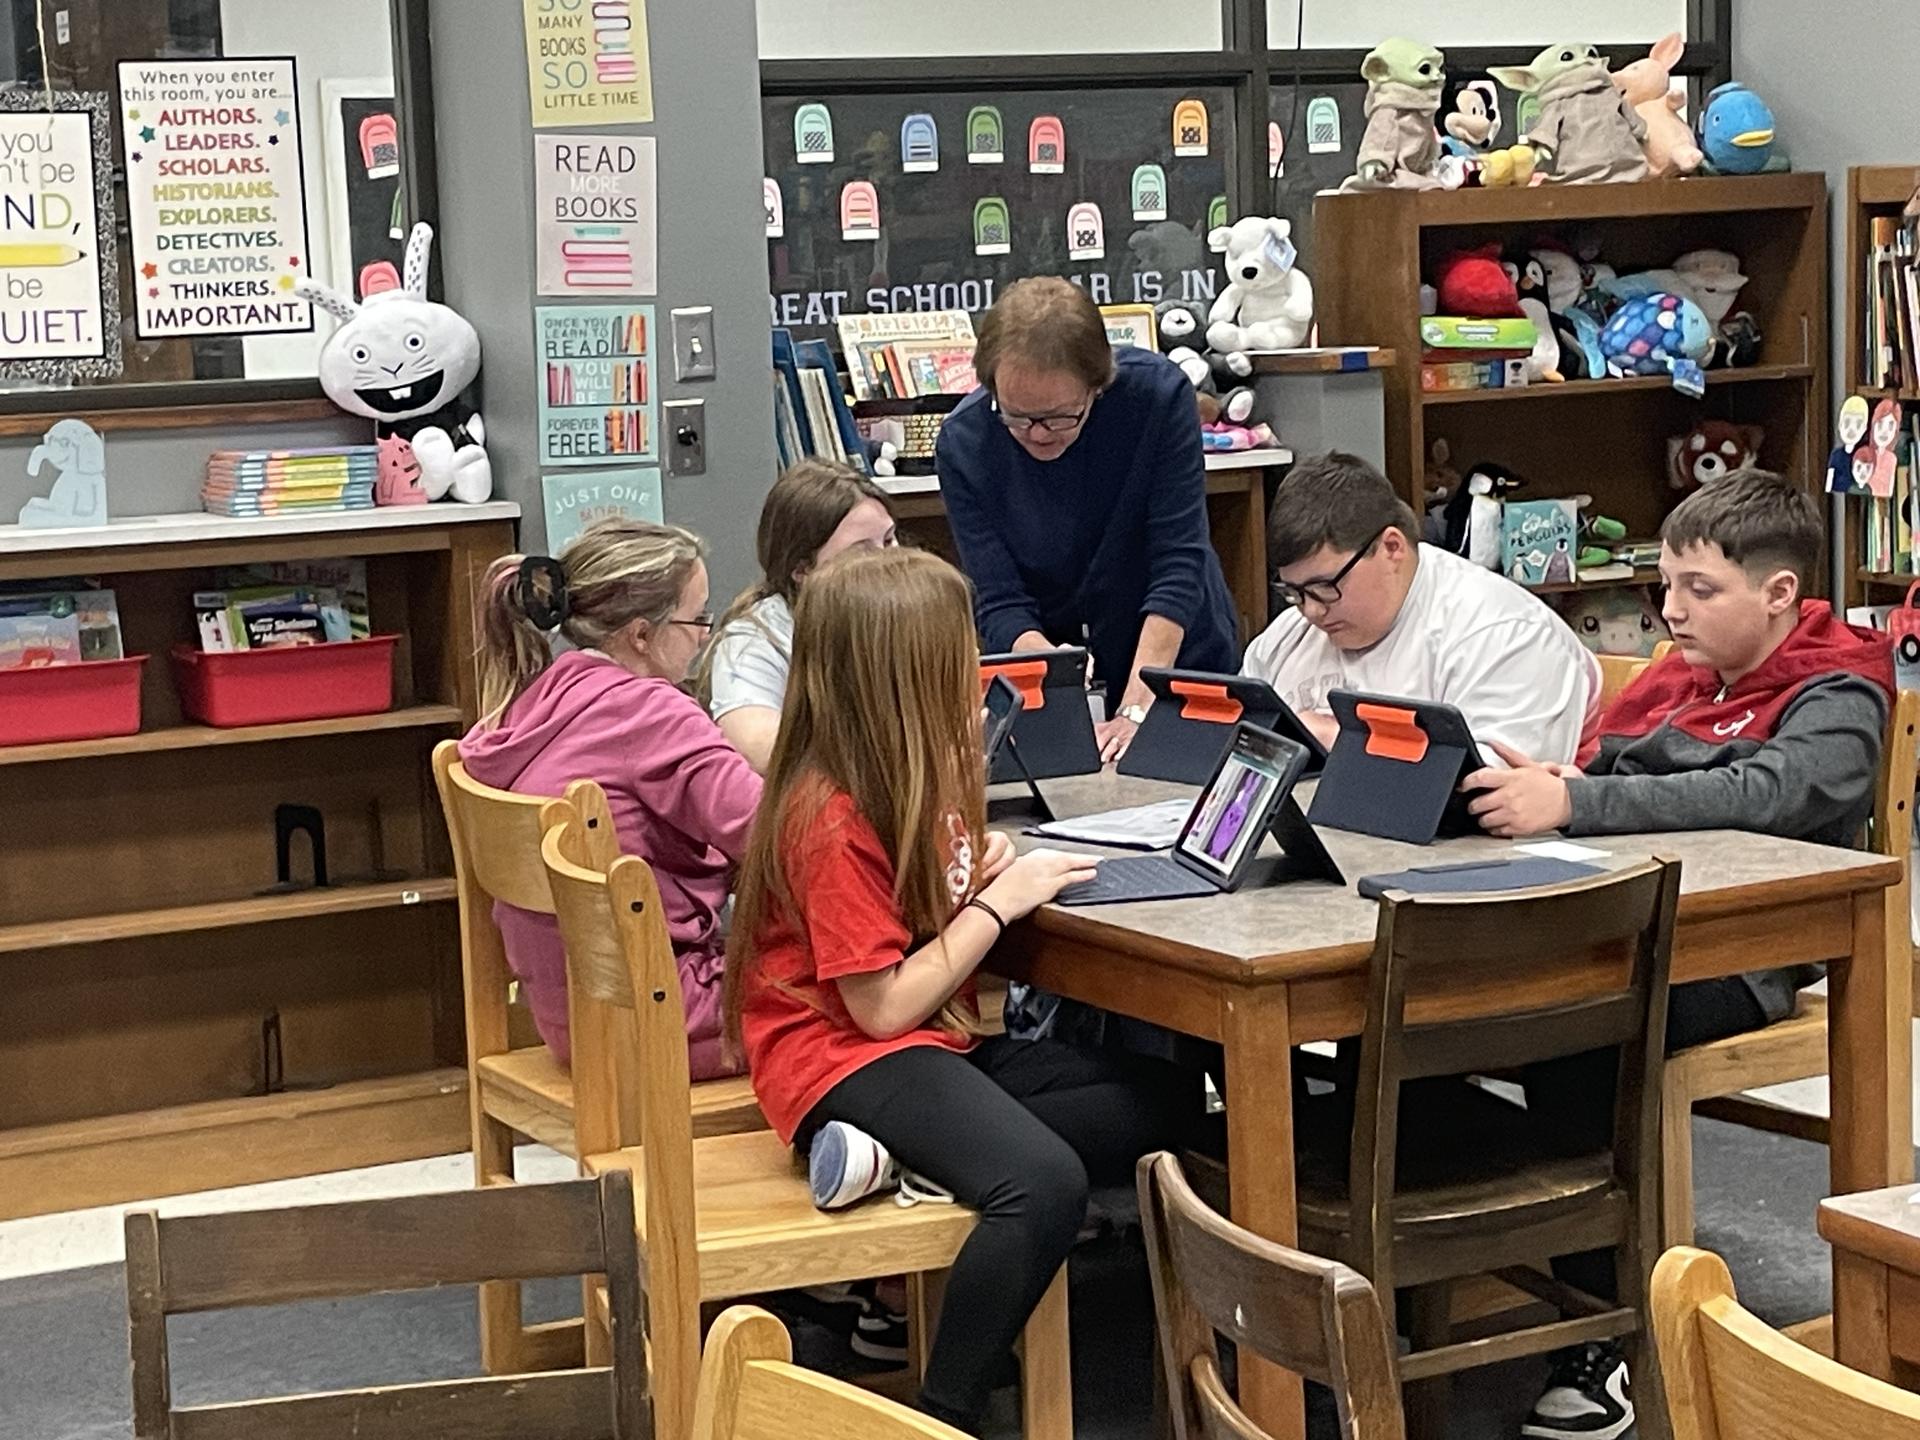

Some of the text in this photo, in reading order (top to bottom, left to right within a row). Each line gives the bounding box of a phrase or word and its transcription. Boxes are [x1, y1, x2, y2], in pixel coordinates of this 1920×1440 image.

[539, 15, 583, 29] MANY
[540, 37, 587, 57] BOOKS
[140, 71, 275, 86] When you enter
[544, 61, 588, 90] SO
[124, 87, 155, 101] this
[161, 89, 210, 102] room,
[215, 89, 246, 103] you
[544, 91, 639, 109] LITTLE TIME
[159, 108, 262, 126] AUTHORS.
[1, 133, 52, 159] you
[165, 133, 260, 151] LEADERS.
[158, 157, 270, 176] SCHOLARS.
[555, 145, 636, 173] READ
[152, 181, 279, 201] HISTORIANS.
[570, 176, 622, 194] MORE
[159, 206, 277, 226] EXPLORERS.
[555, 197, 637, 218] BOOKS
[157, 231, 283, 251] DETECTIVES.
[168, 255, 275, 275] CREATORS.
[7, 272, 43, 299] be
[170, 280, 276, 299] THINKERS.
[1133, 271, 1162, 303] IS
[1182, 269, 1216, 300] IN
[147, 303, 303, 329] IMPORTANT.
[544, 318, 609, 329] ONCE YOU
[545, 328, 609, 339] LEARN TO
[546, 340, 609, 356] READ
[575, 361, 611, 375] YOU
[576, 377, 611, 390] WILL
[576, 391, 598, 404] BE
[547, 418, 599, 431] FOREVER
[548, 433, 600, 456] FREE
[555, 485, 652, 515] JUST ONE
[1510, 523, 1571, 547] PENGUINS
